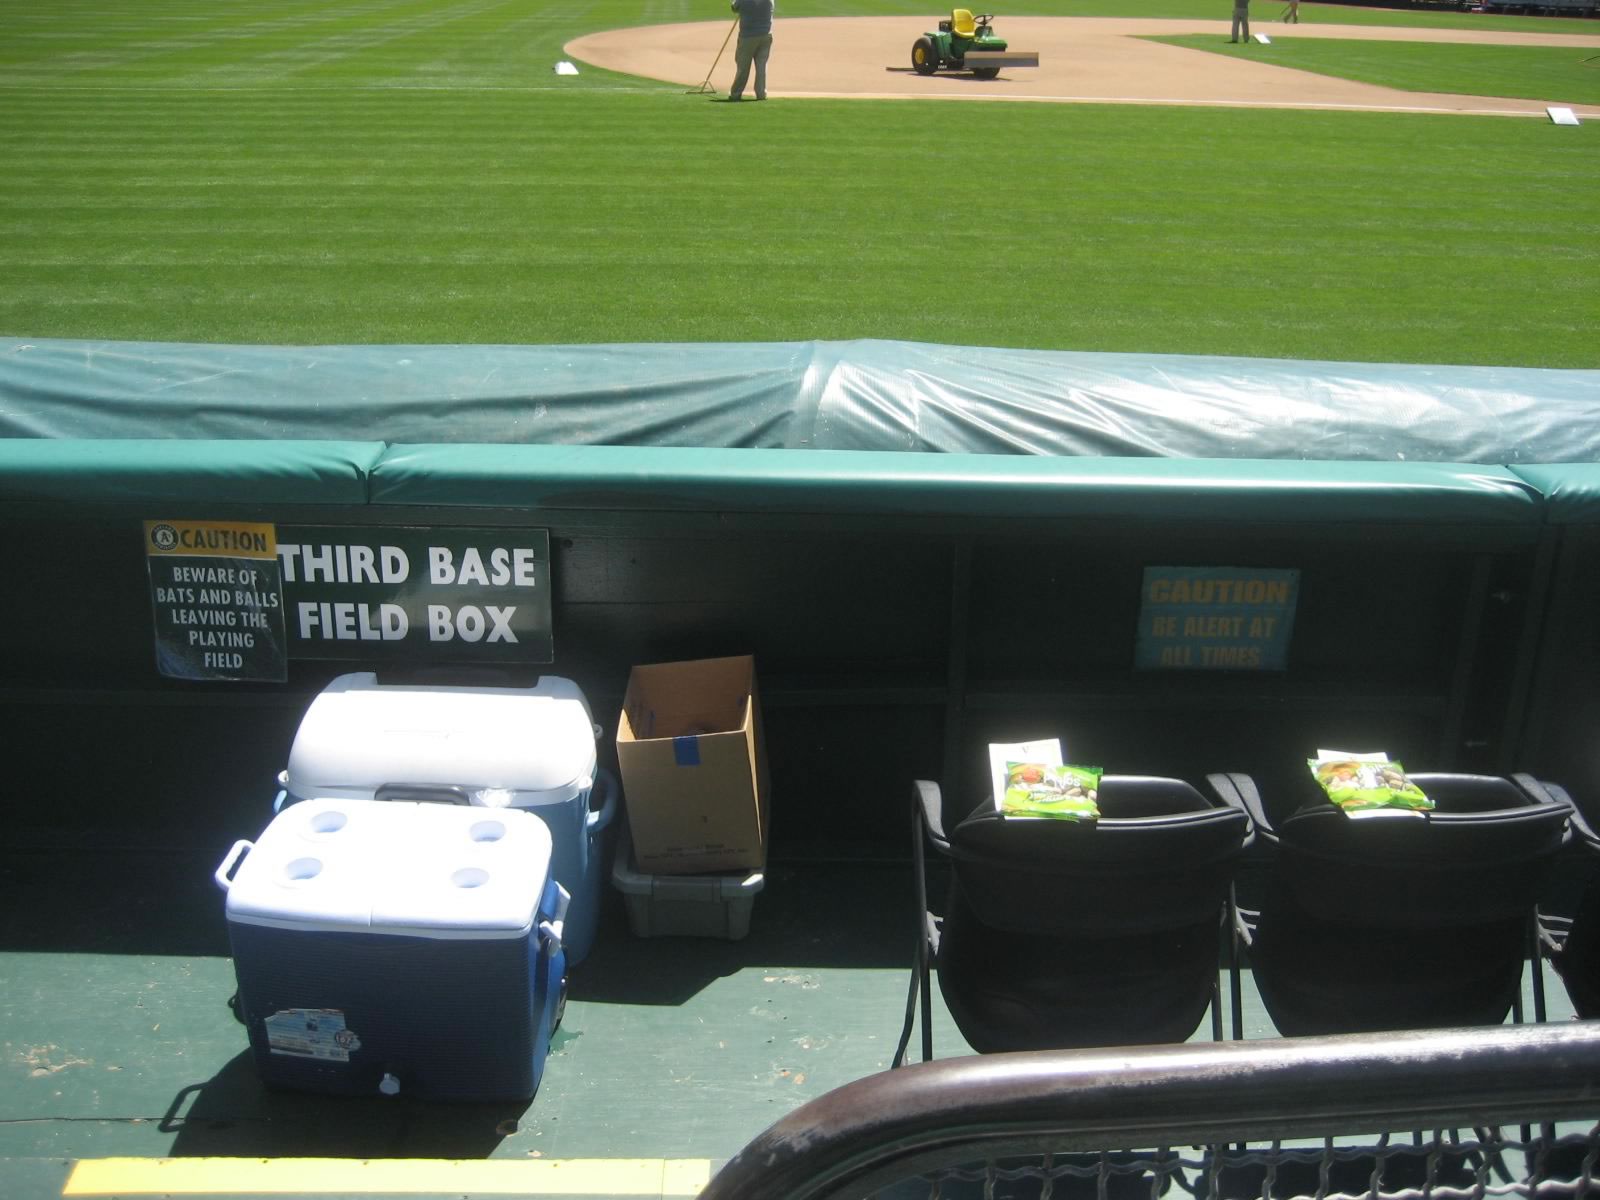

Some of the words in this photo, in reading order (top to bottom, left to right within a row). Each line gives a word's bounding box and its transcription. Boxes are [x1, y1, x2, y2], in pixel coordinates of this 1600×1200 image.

[180, 529, 268, 553] CAUTION
[173, 566, 236, 584] BEWARE
[239, 569, 258, 585] OF
[276, 543, 410, 584] THIRD
[428, 546, 536, 587] BASE
[156, 587, 195, 603] BATS
[199, 589, 231, 605] AND
[235, 590, 279, 608] BALLS
[1150, 578, 1290, 605] CAUTION
[171, 608, 237, 627] LEAVING
[240, 611, 268, 628] THE
[298, 602, 409, 641] FIELD
[427, 604, 519, 644] BOX
[1151, 616, 1177, 638] BE
[1183, 616, 1244, 638] ALERT
[1248, 617, 1277, 639] AT
[189, 630, 255, 648] PLAYING
[204, 652, 243, 668] FIELD
[1160, 646, 1193, 667] ALL
[1199, 645, 1261, 668] TIMES
